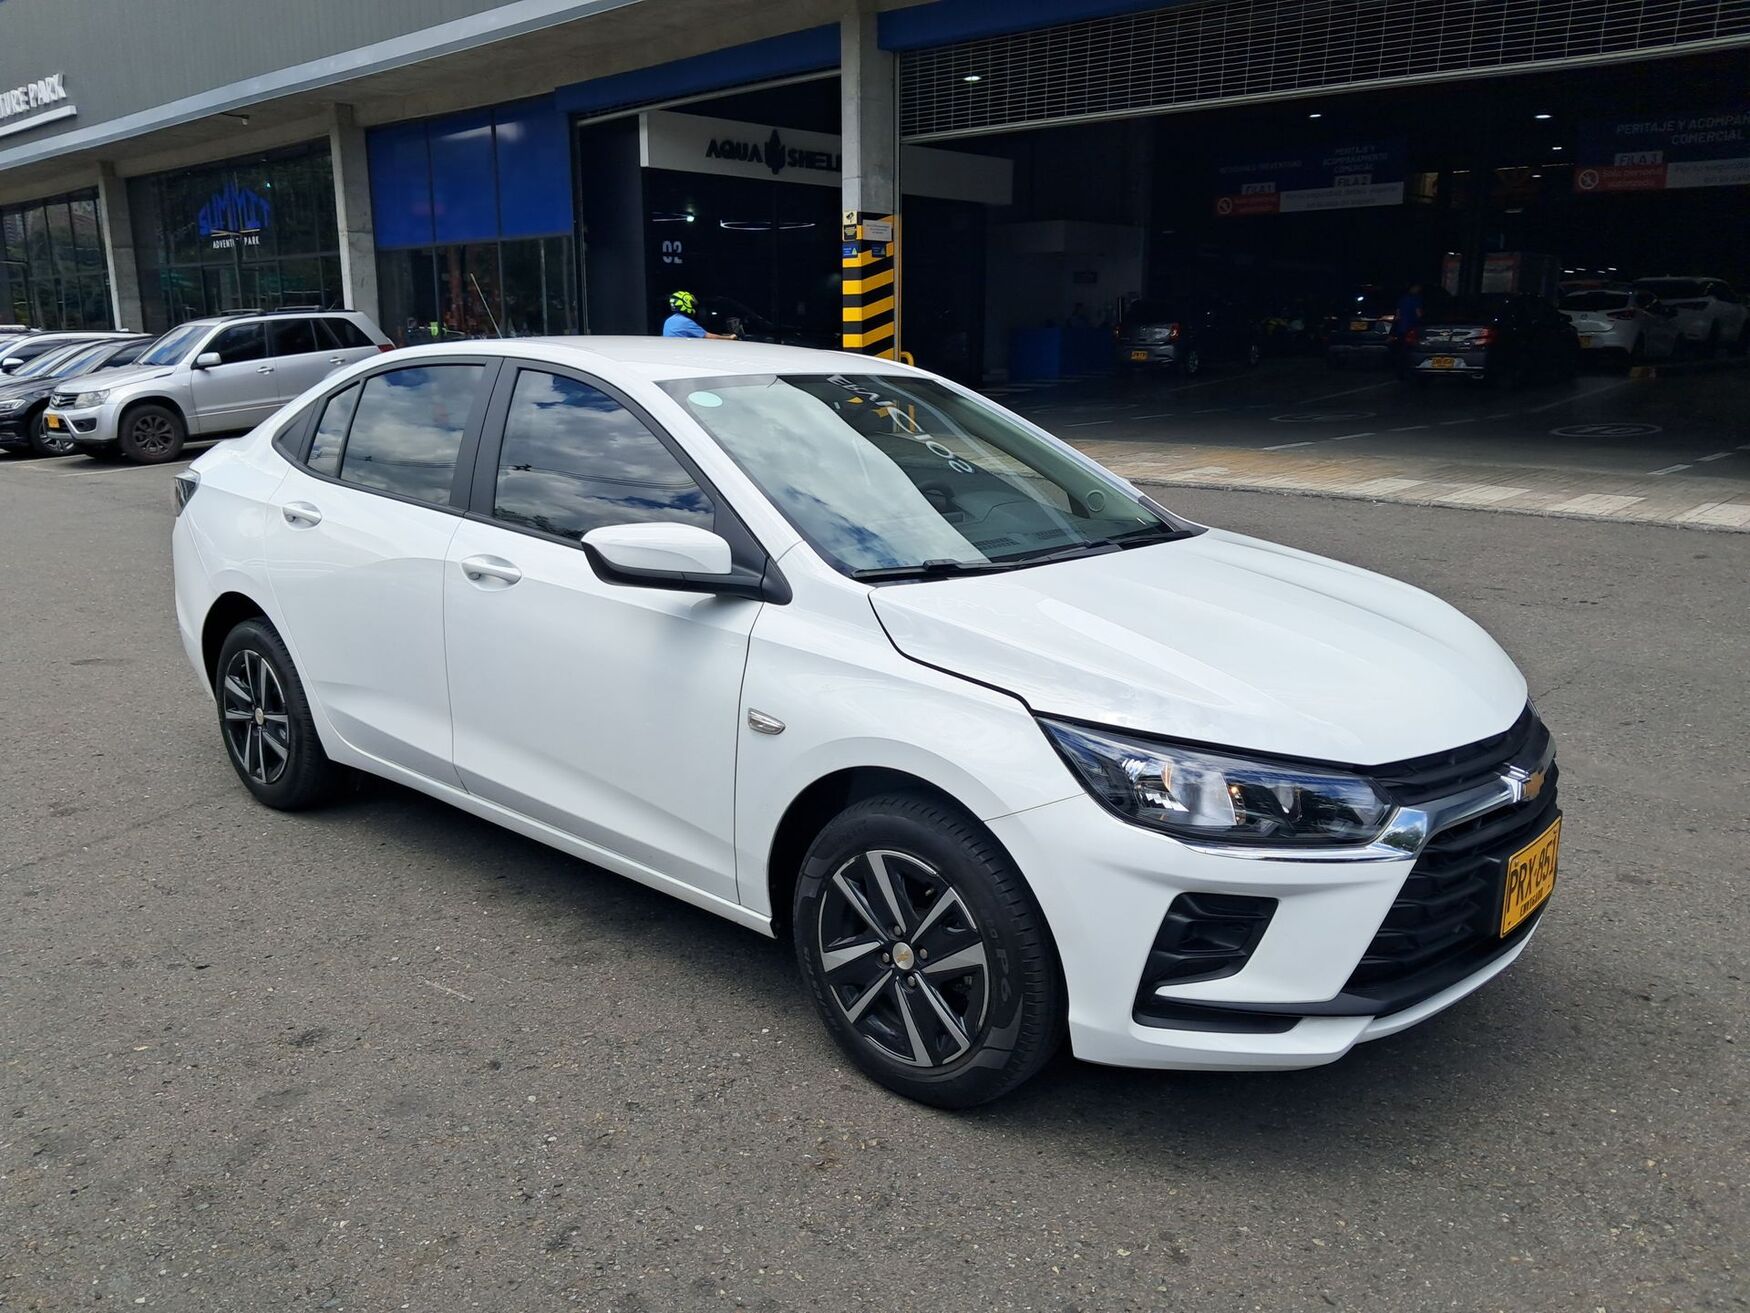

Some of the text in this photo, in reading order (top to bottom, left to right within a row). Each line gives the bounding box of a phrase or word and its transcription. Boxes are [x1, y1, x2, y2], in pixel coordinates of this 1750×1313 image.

[28, 72, 67, 107] PARK
[1671, 129, 1745, 145] COMERCIAL
[705, 138, 764, 163] AQUA
[243, 235, 260, 246] PARK
[661, 240, 684, 264] 02
